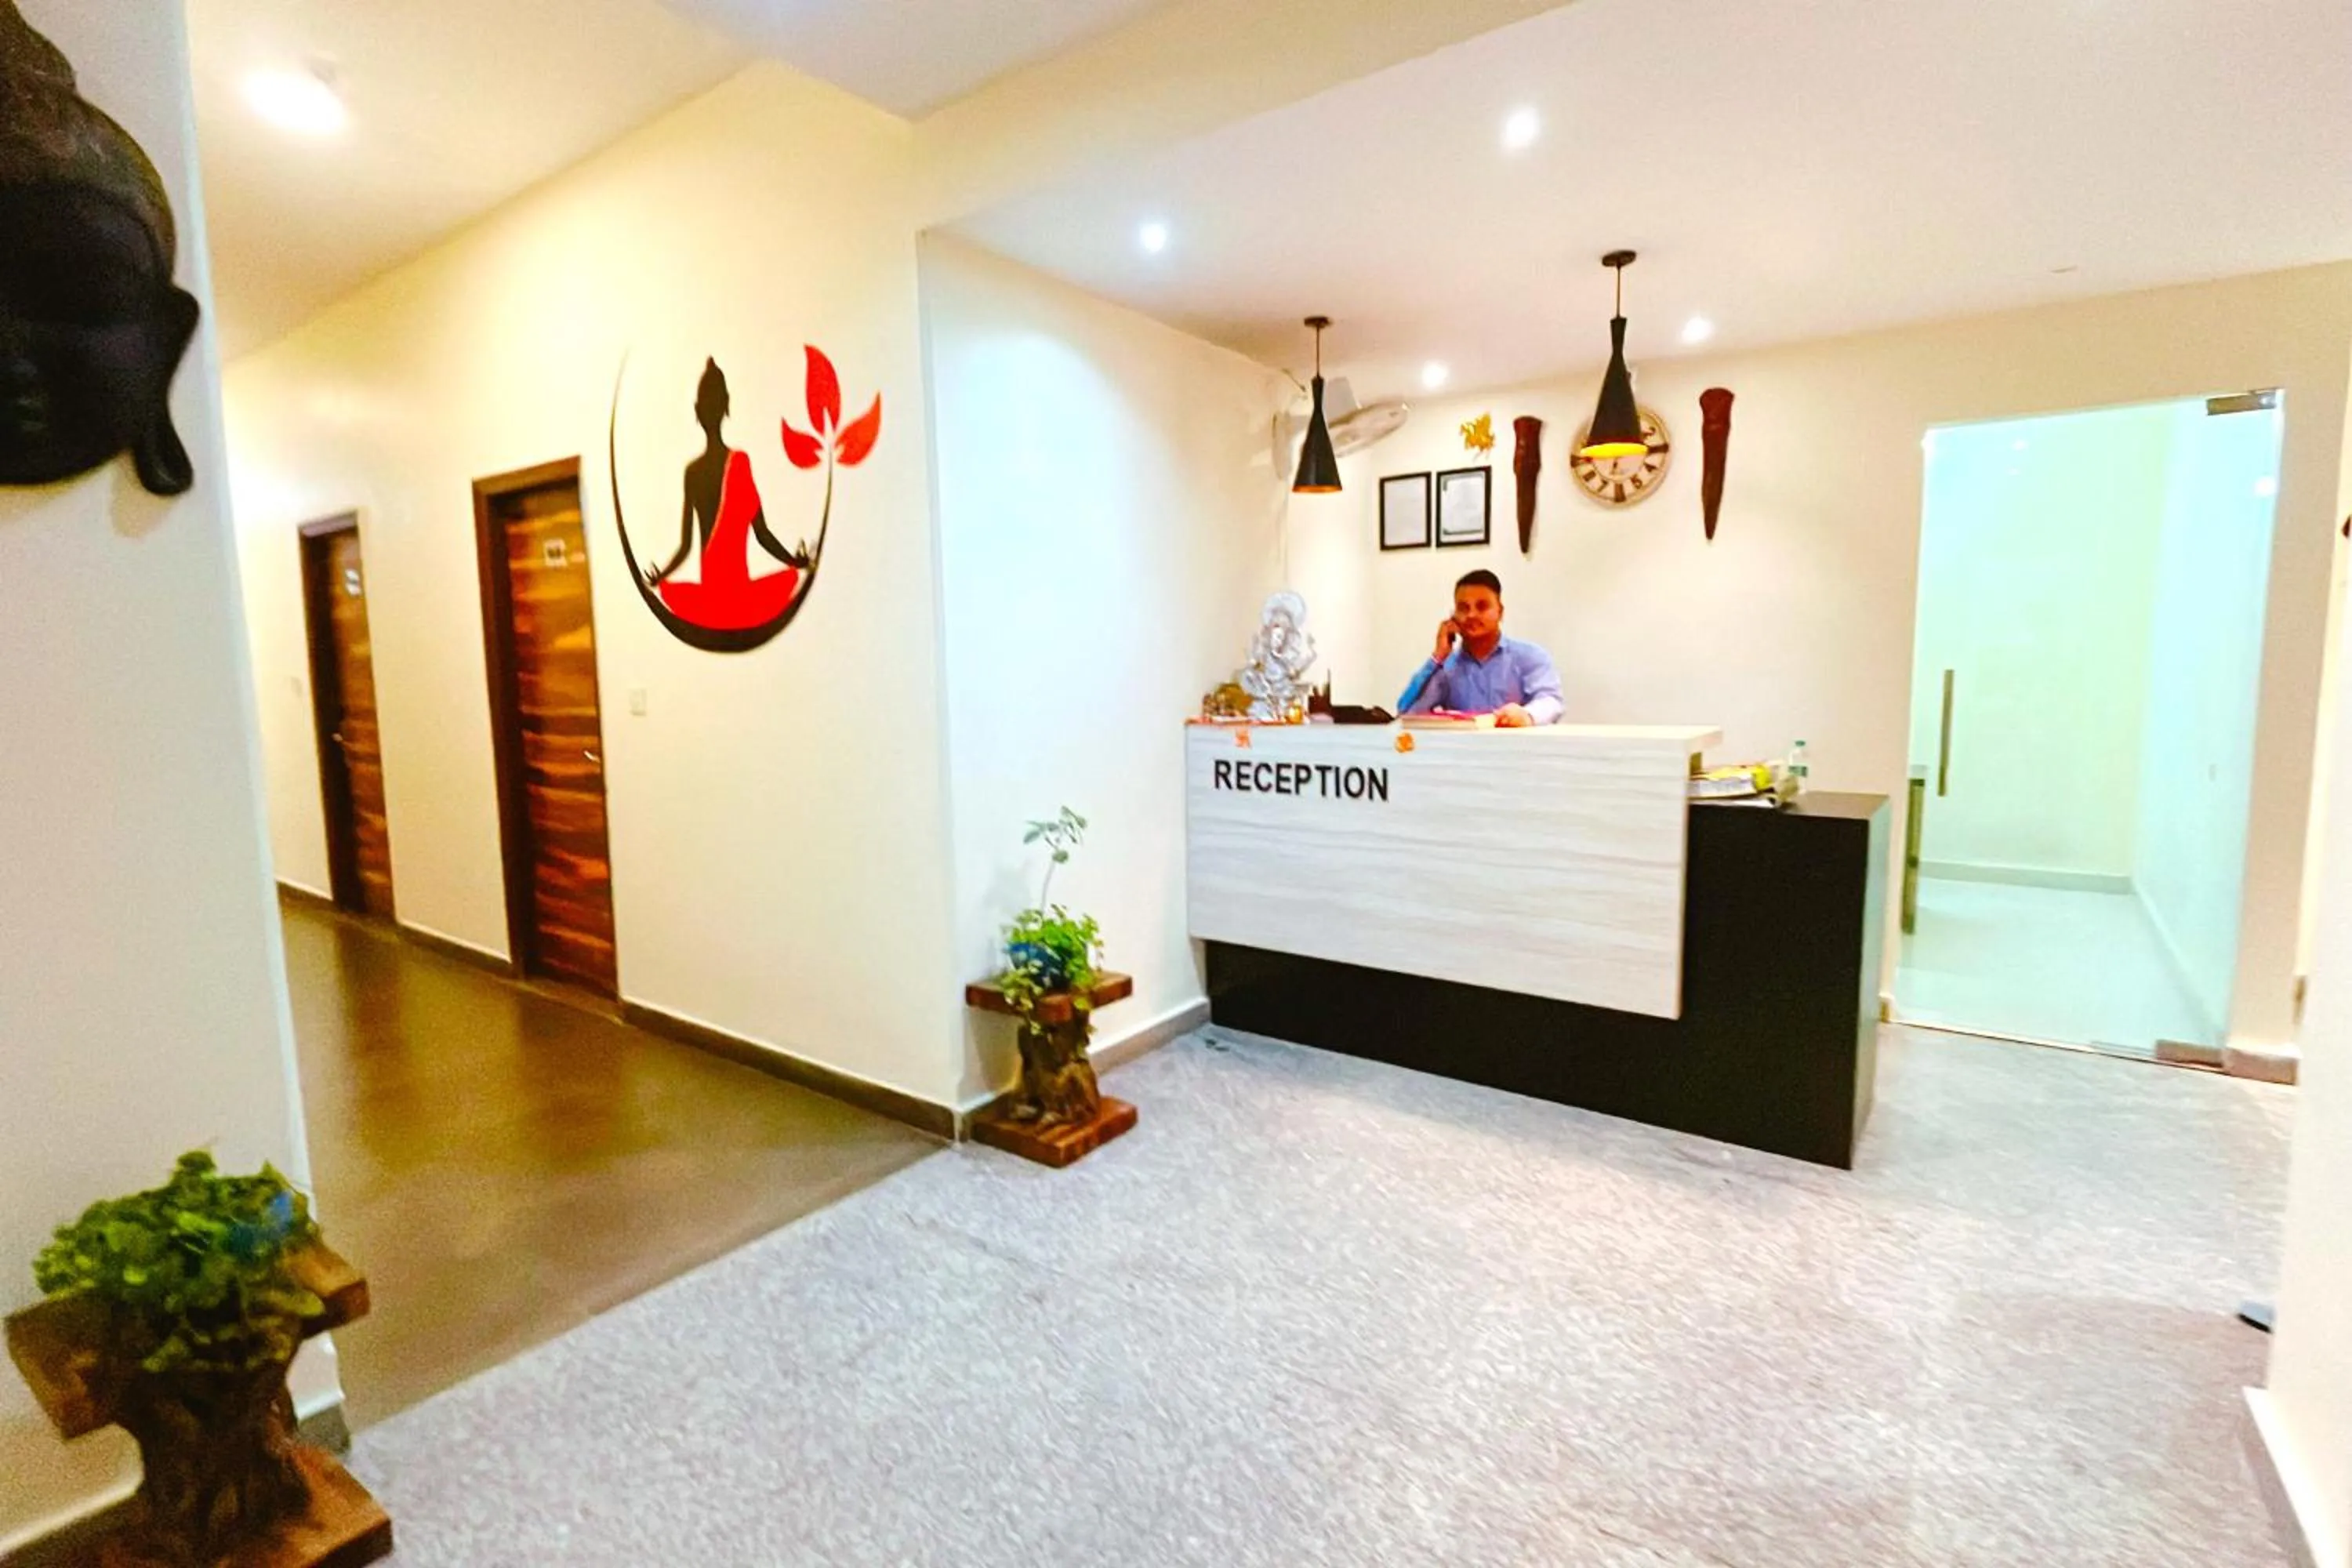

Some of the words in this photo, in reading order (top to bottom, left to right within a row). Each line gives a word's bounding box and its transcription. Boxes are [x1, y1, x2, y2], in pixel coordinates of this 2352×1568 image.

[1597, 479, 1609, 492] 7
[1630, 474, 1642, 489] 5
[1214, 759, 1388, 801] RECEPTION
